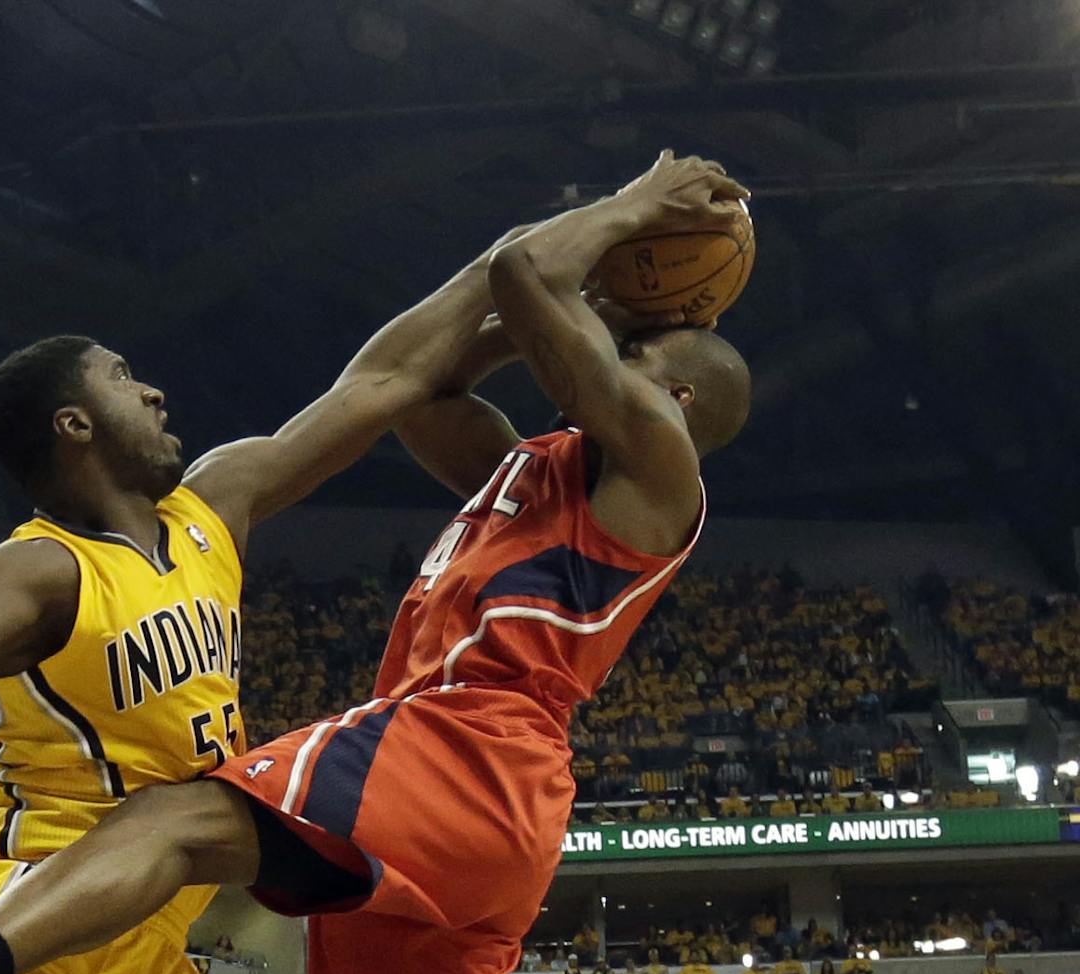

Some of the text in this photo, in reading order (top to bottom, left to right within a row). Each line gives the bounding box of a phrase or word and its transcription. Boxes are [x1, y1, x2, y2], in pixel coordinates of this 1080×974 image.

[621, 826, 746, 850] LONG-TERM
[751, 823, 808, 845] CARE
[827, 817, 942, 842] ANNUITIES
